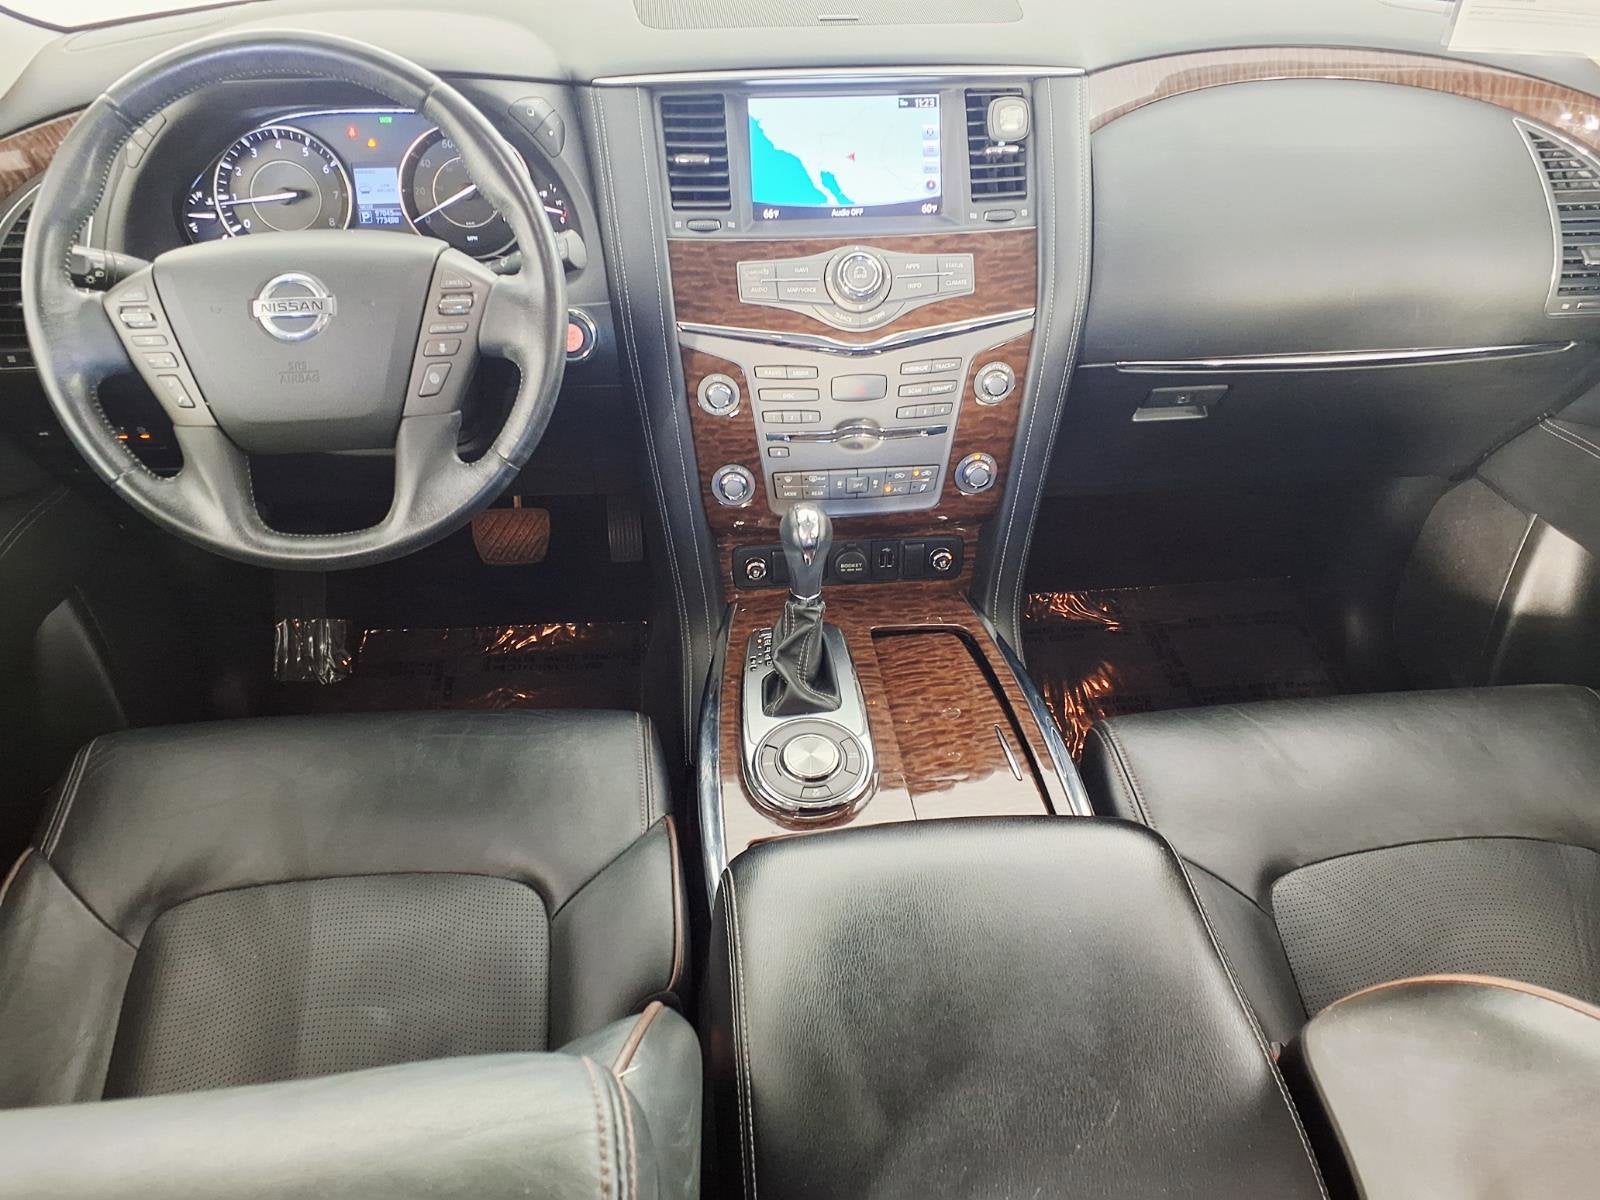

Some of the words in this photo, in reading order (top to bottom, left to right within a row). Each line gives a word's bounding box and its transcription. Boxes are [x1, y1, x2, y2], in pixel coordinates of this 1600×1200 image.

[275, 142, 282, 150] 4
[251, 148, 258, 158] 3
[302, 147, 309, 157] 5
[235, 167, 242, 176] 2
[322, 166, 330, 174] 6
[831, 208, 850, 217] Audio
[851, 208, 864, 217] OFF
[244, 219, 251, 228] 0
[260, 300, 324, 313] NISSAN
[280, 373, 320, 384] AIRBAG
